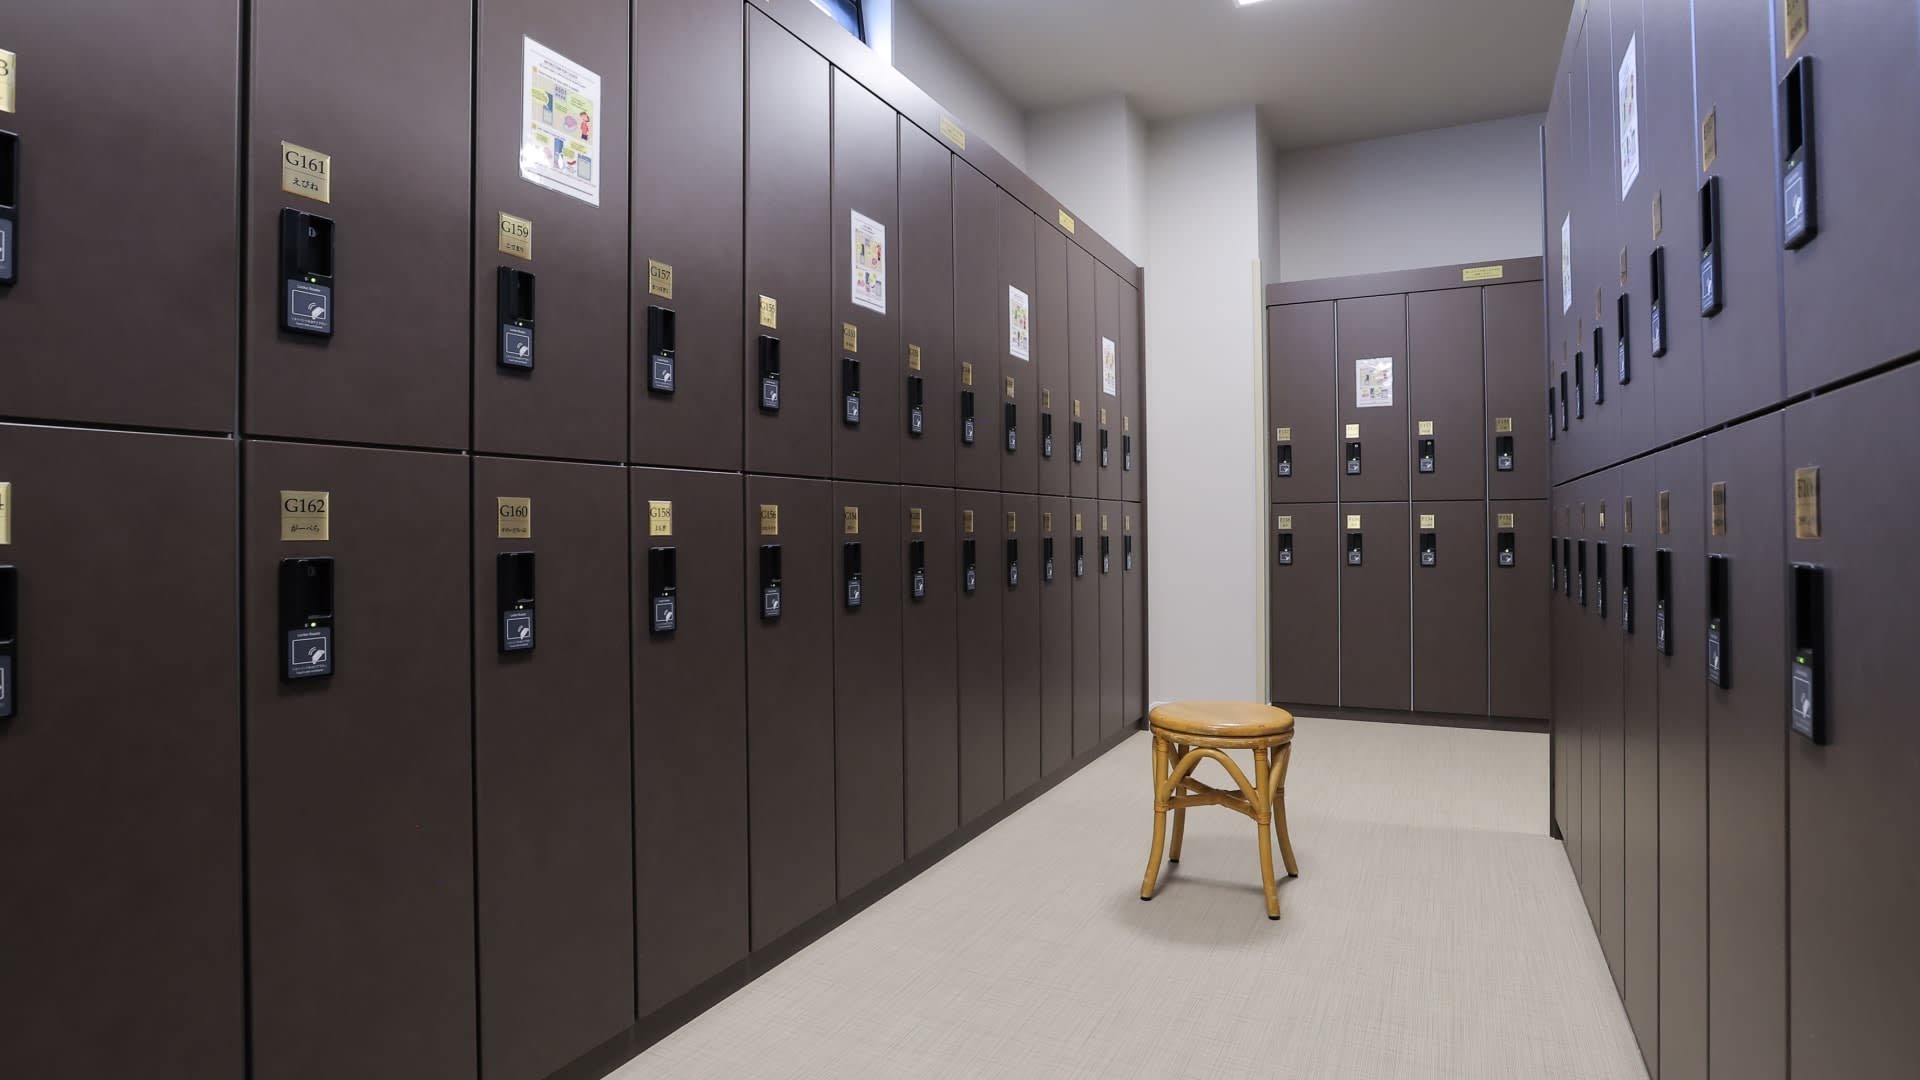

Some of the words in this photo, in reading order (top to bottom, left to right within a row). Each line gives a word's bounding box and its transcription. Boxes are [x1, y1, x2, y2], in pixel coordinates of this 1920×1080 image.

[285, 150, 326, 174] G161
[501, 220, 529, 238] G159
[650, 265, 671, 280] G157
[284, 498, 326, 513] G162
[499, 504, 528, 518] G160
[650, 507, 671, 518] G158
